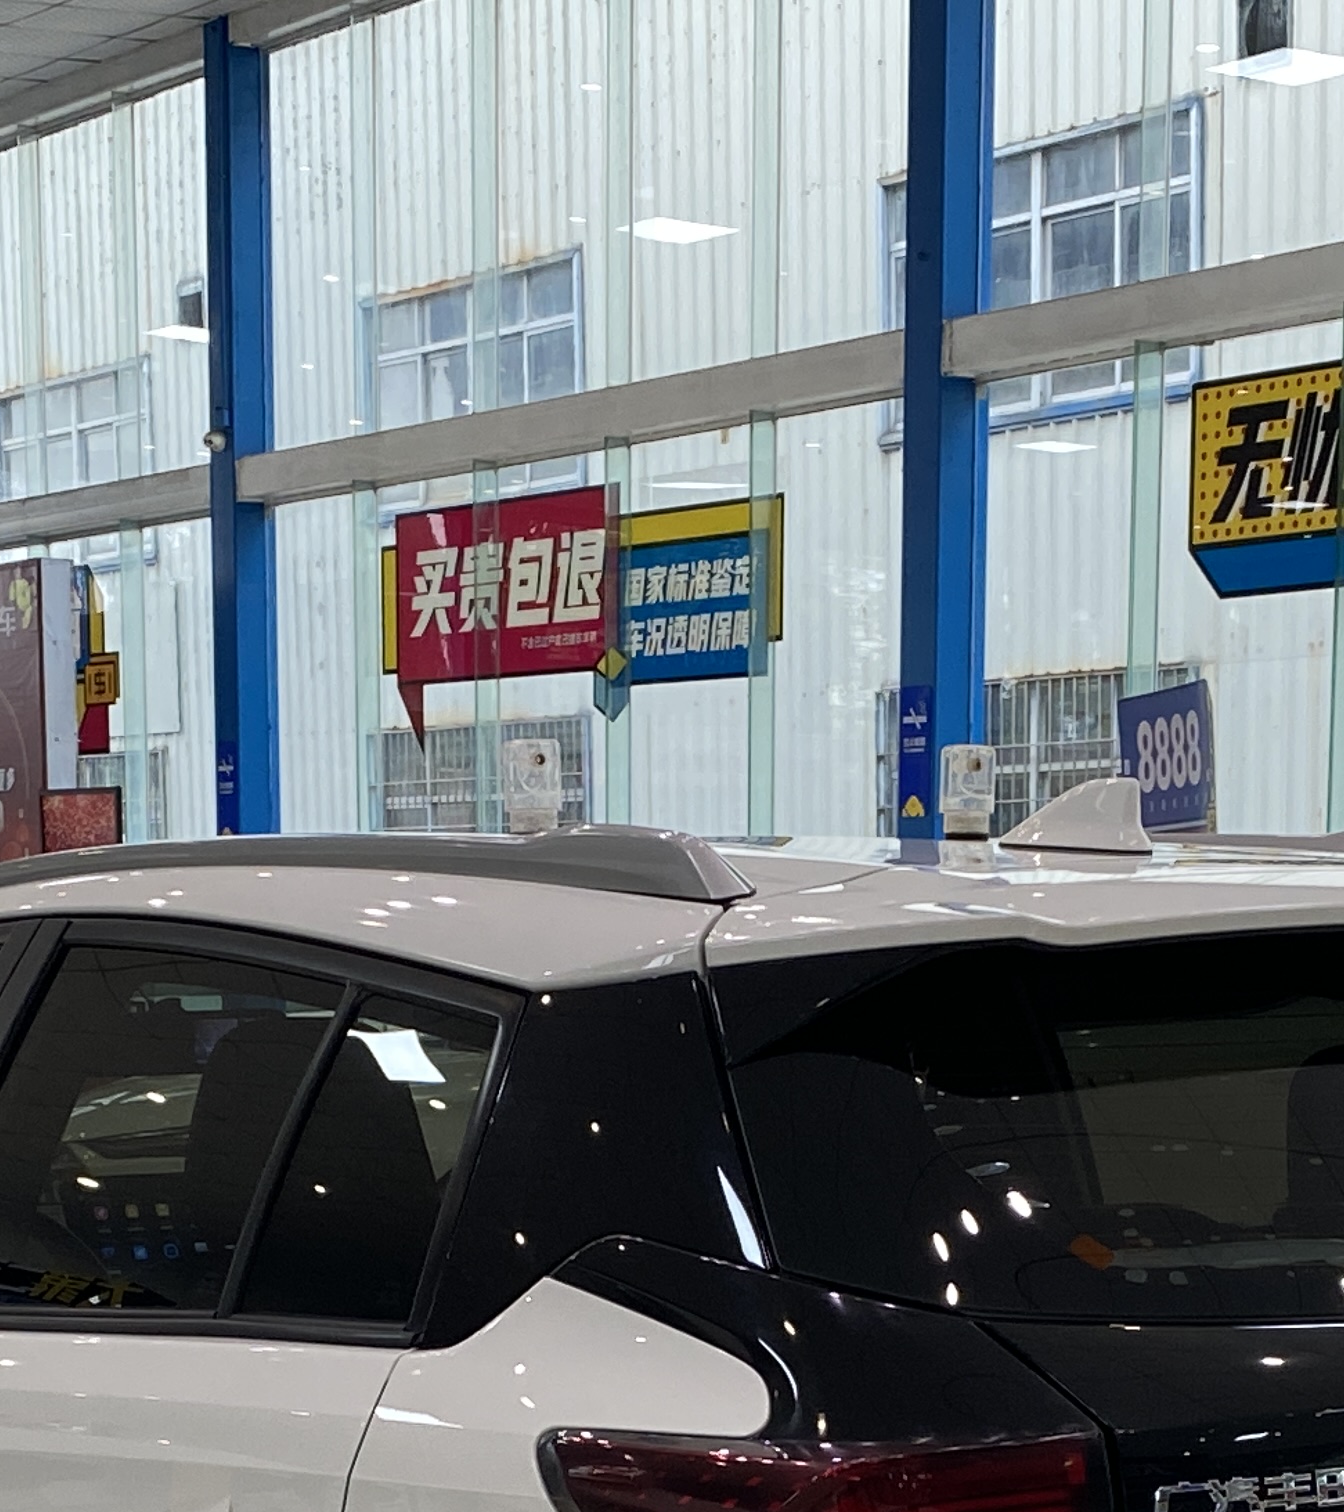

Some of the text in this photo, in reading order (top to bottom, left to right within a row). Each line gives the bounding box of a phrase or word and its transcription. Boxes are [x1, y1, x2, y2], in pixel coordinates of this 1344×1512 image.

[411, 530, 606, 638] 买贵包退
[1137, 709, 1201, 793] 8888
